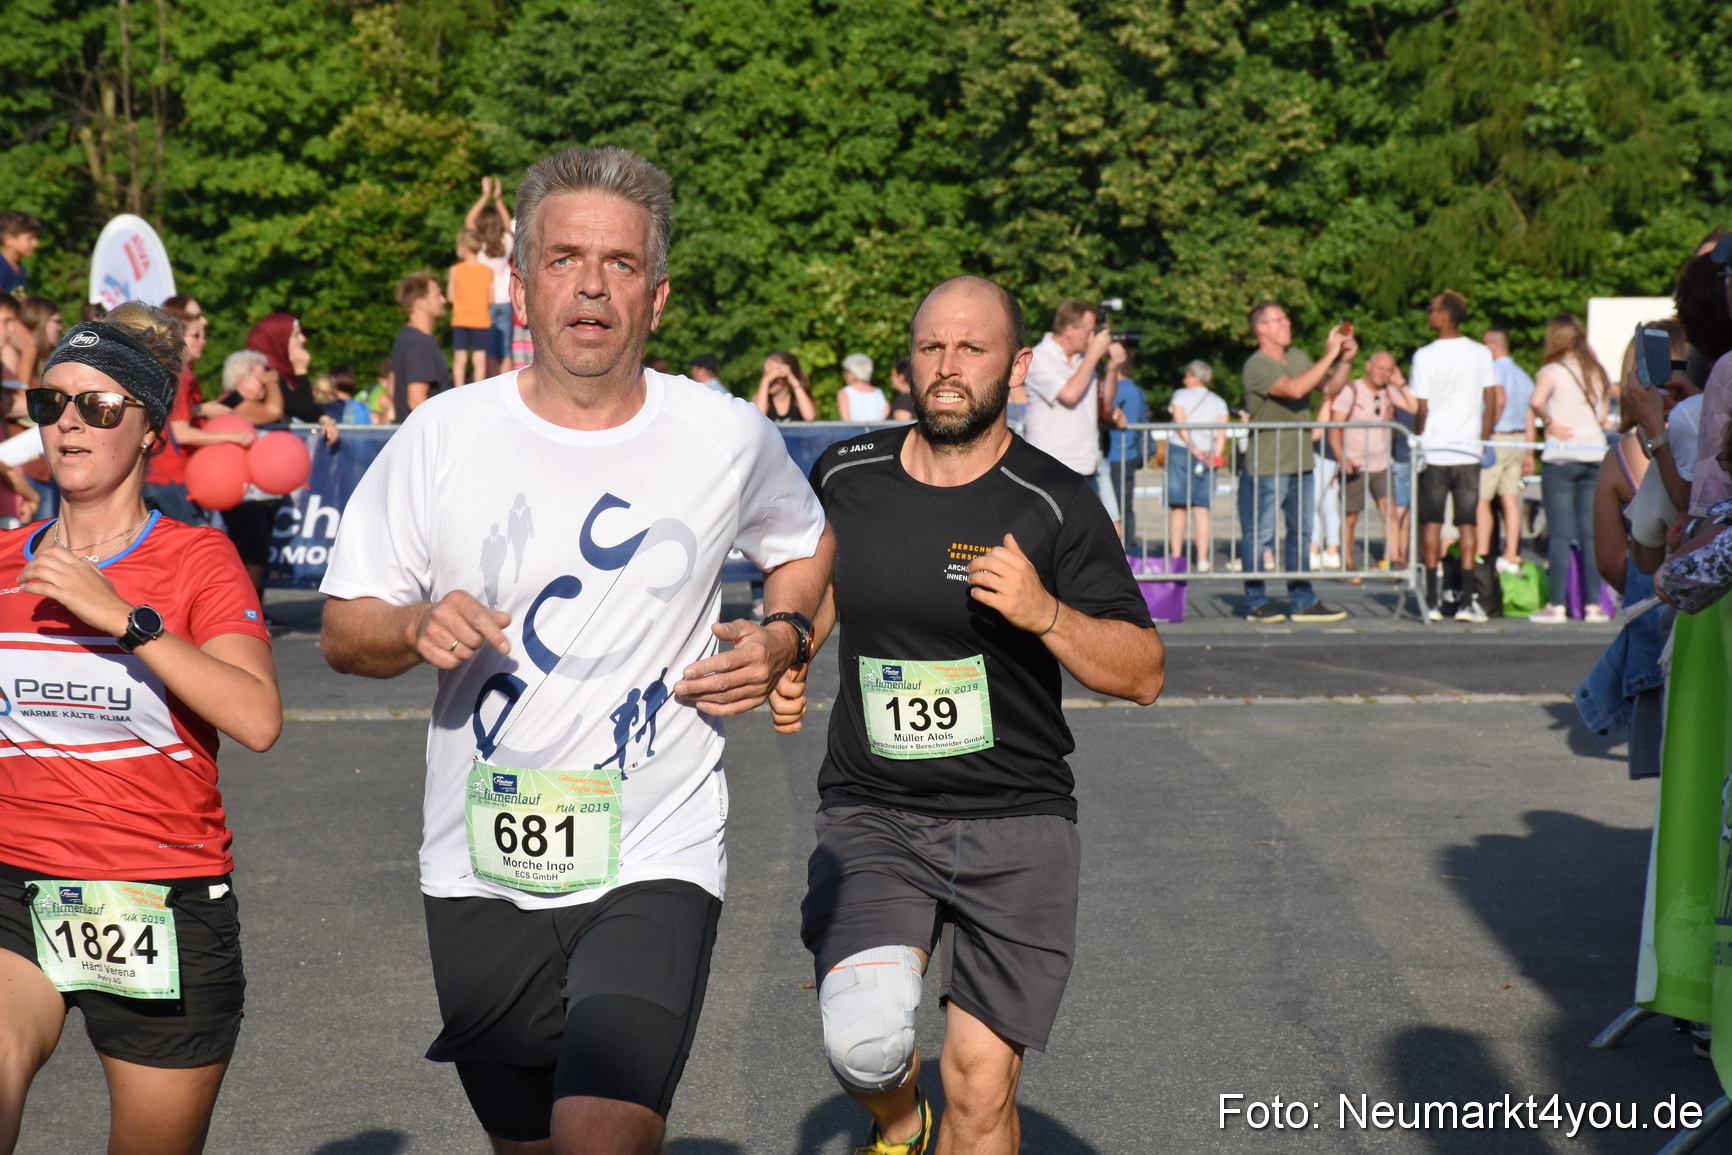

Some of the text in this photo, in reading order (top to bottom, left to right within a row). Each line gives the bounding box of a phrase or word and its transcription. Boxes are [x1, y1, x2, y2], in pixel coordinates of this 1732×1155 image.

[72, 333, 97, 345] Buff
[849, 443, 874, 453] JAKO
[272, 494, 341, 539] ch
[946, 573, 968, 582] INNEN
[875, 677, 922, 690] firmenlauf
[954, 683, 979, 694] 2019
[14, 678, 132, 711] Petry
[885, 696, 958, 732] 139
[893, 732, 954, 742] Müller Alois
[916, 740, 962, 750] Berschneider
[963, 735, 986, 745] GmbH
[484, 788, 542, 806] firmenlauf
[580, 802, 610, 813] 2019
[494, 811, 575, 858] 681
[503, 856, 575, 873] Morche Ingo
[515, 871, 531, 880] ECS
[533, 872, 558, 881] GmbH
[52, 902, 106, 915] firmenlauf
[141, 914, 166, 924] 2019
[55, 920, 158, 965] 1824
[103, 964, 136, 978] Verena
[113, 977, 122, 985] AG
